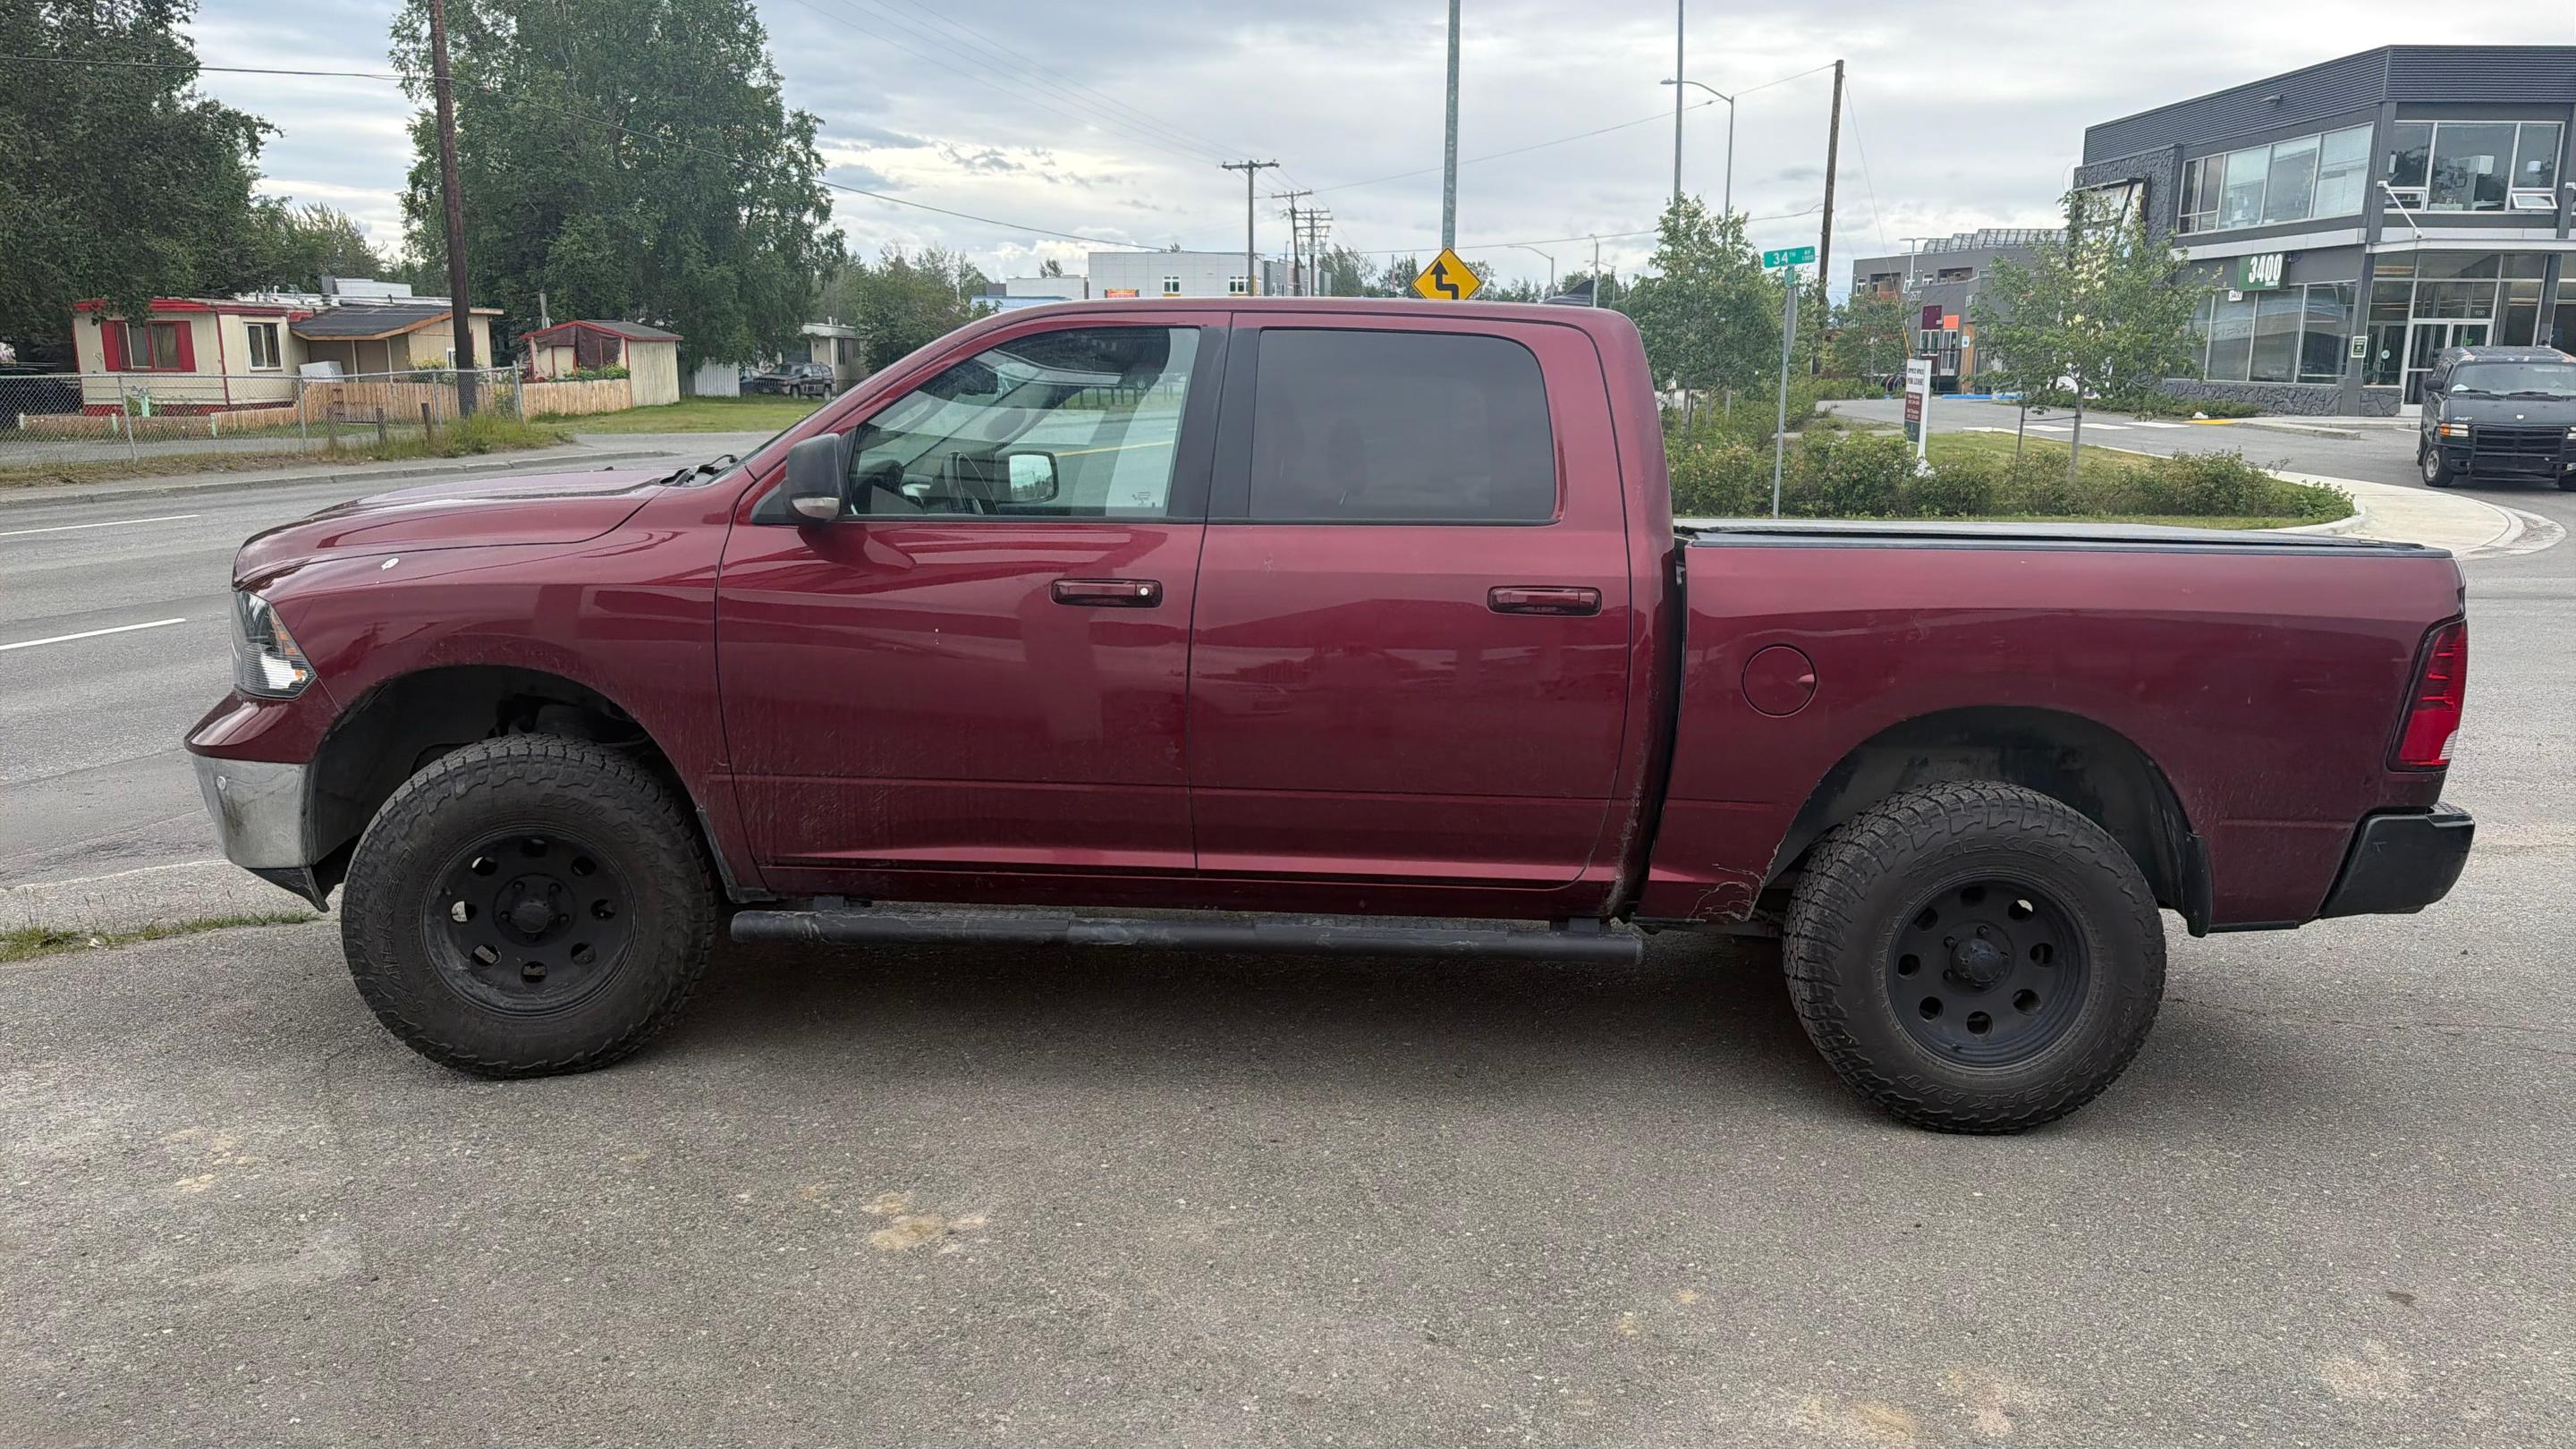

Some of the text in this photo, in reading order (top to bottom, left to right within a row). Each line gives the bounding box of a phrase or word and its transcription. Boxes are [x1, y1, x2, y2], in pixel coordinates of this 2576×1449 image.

[2248, 253, 2283, 284] 3400
[1914, 377, 1924, 386] LEASE
[1903, 834, 2088, 877] FALKEN
